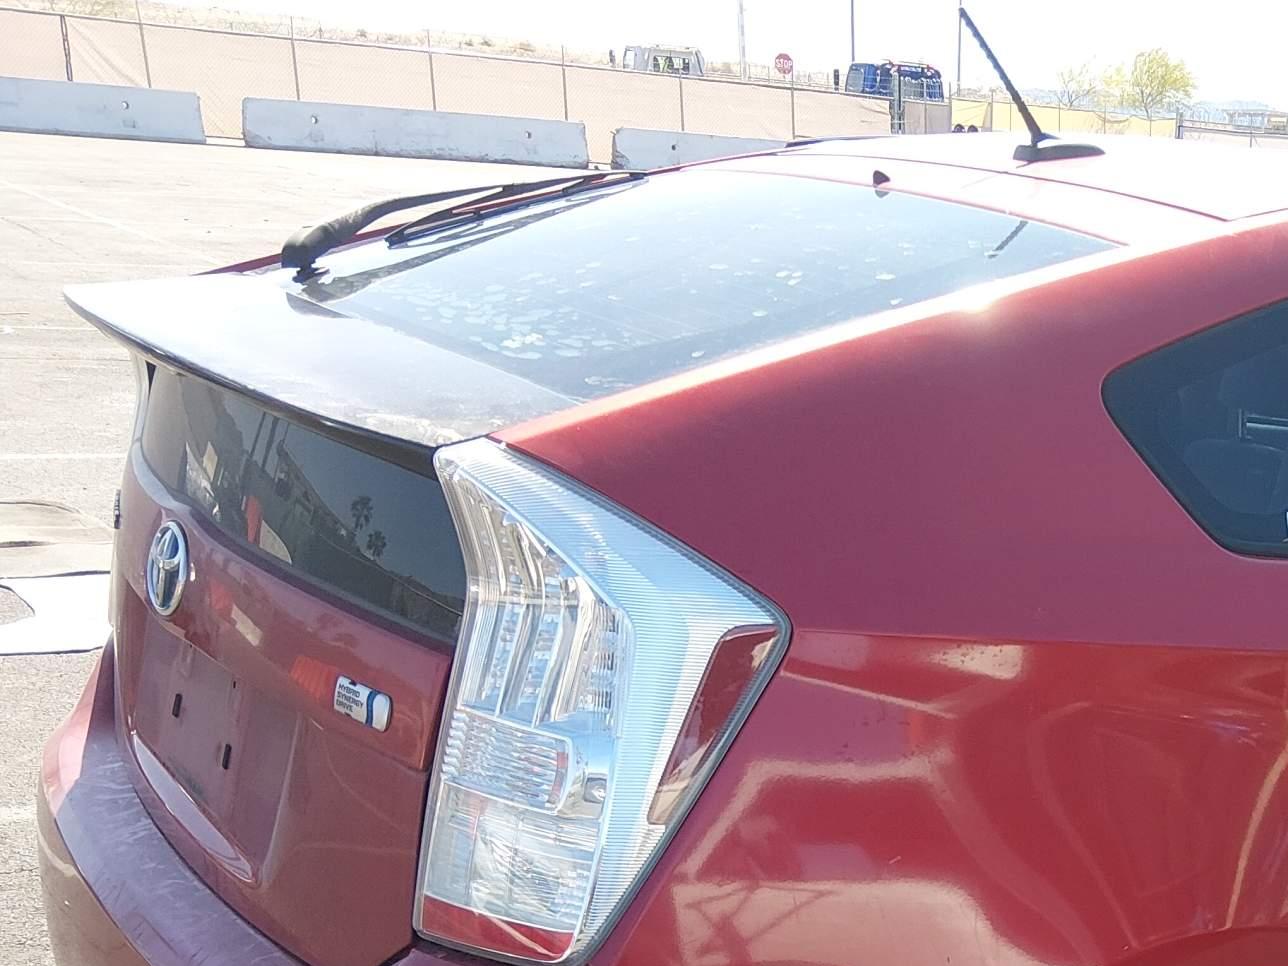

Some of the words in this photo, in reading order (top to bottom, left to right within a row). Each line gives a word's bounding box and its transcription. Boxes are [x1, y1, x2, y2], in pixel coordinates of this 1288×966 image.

[775, 58, 792, 69] STOP
[338, 683, 361, 699] HYBRID
[335, 698, 354, 712] DRIVE
[336, 690, 364, 709] SYNERGY
